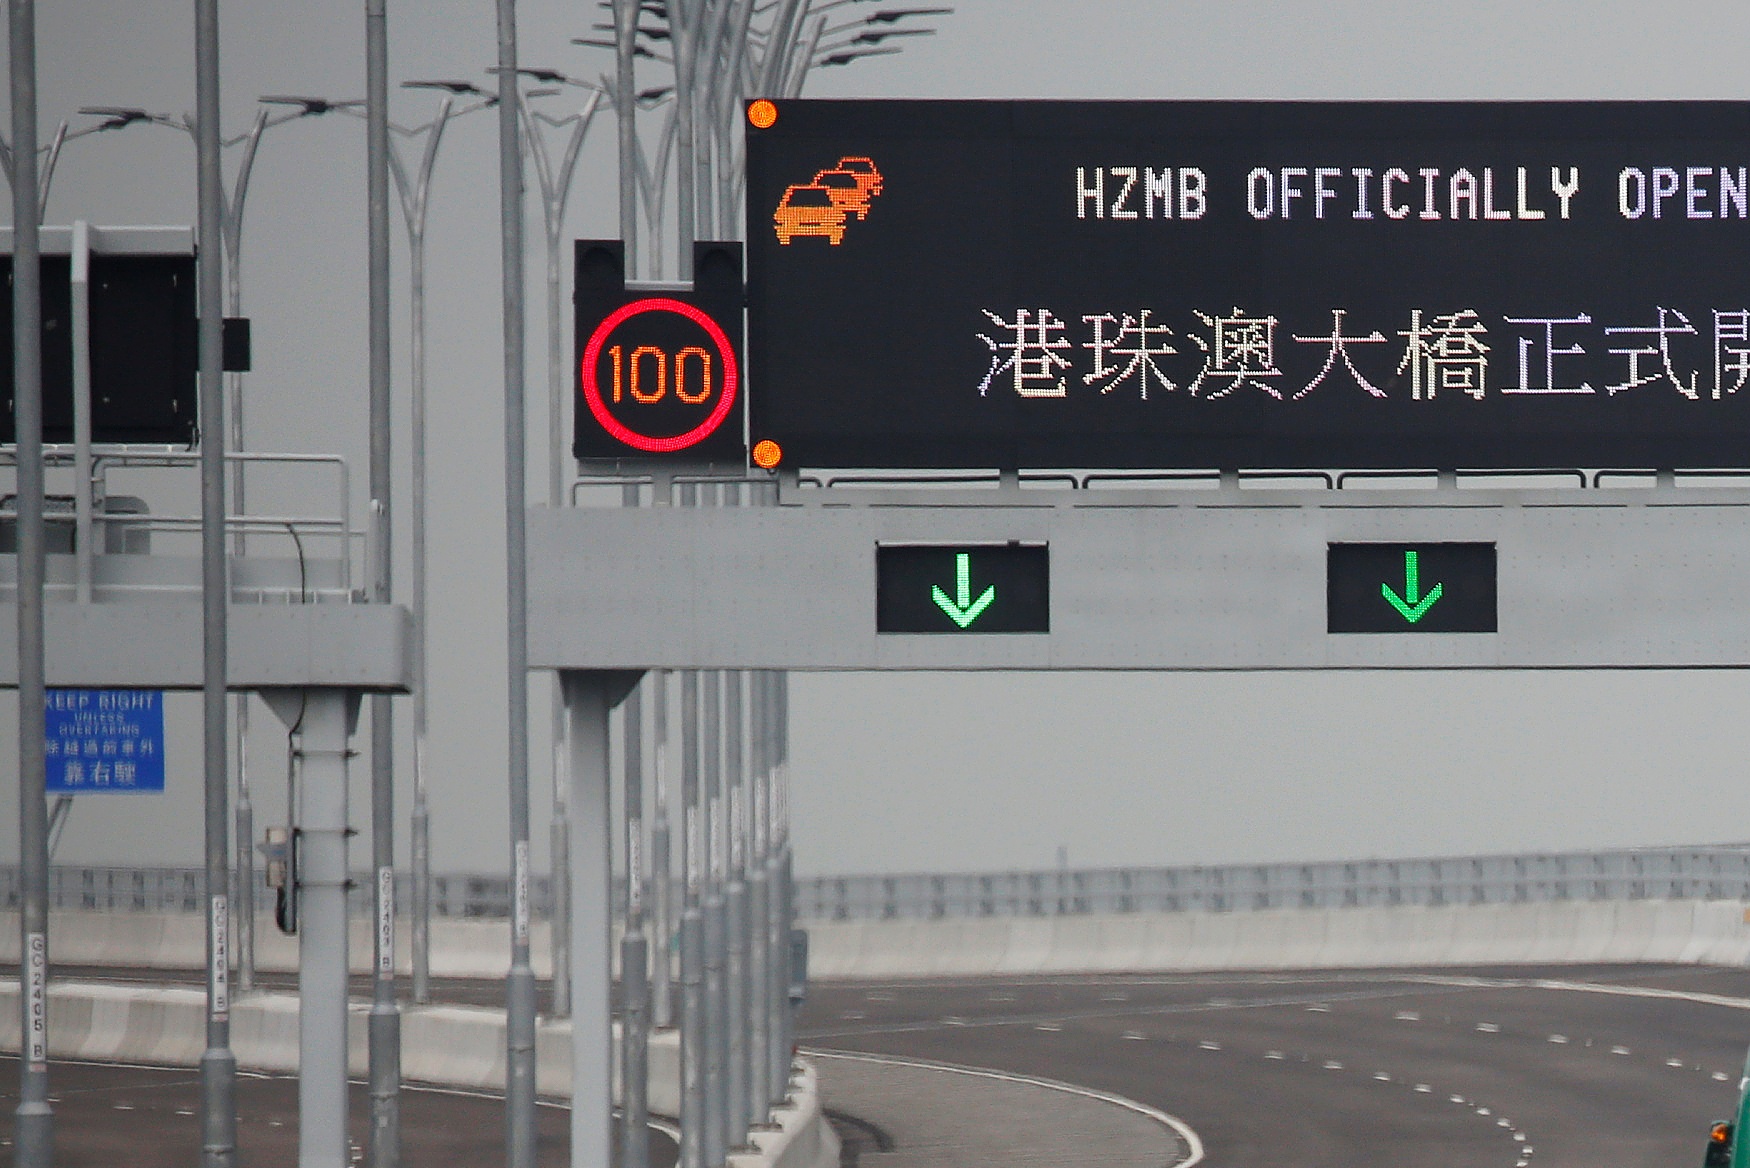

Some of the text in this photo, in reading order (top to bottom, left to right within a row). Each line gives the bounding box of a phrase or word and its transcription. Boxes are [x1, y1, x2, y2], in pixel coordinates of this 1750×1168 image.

[1076, 166, 1206, 220] HZMB
[1246, 166, 1580, 220] OFFICIALLY
[608, 344, 712, 405] 100
[98, 691, 153, 711] RIGHT
